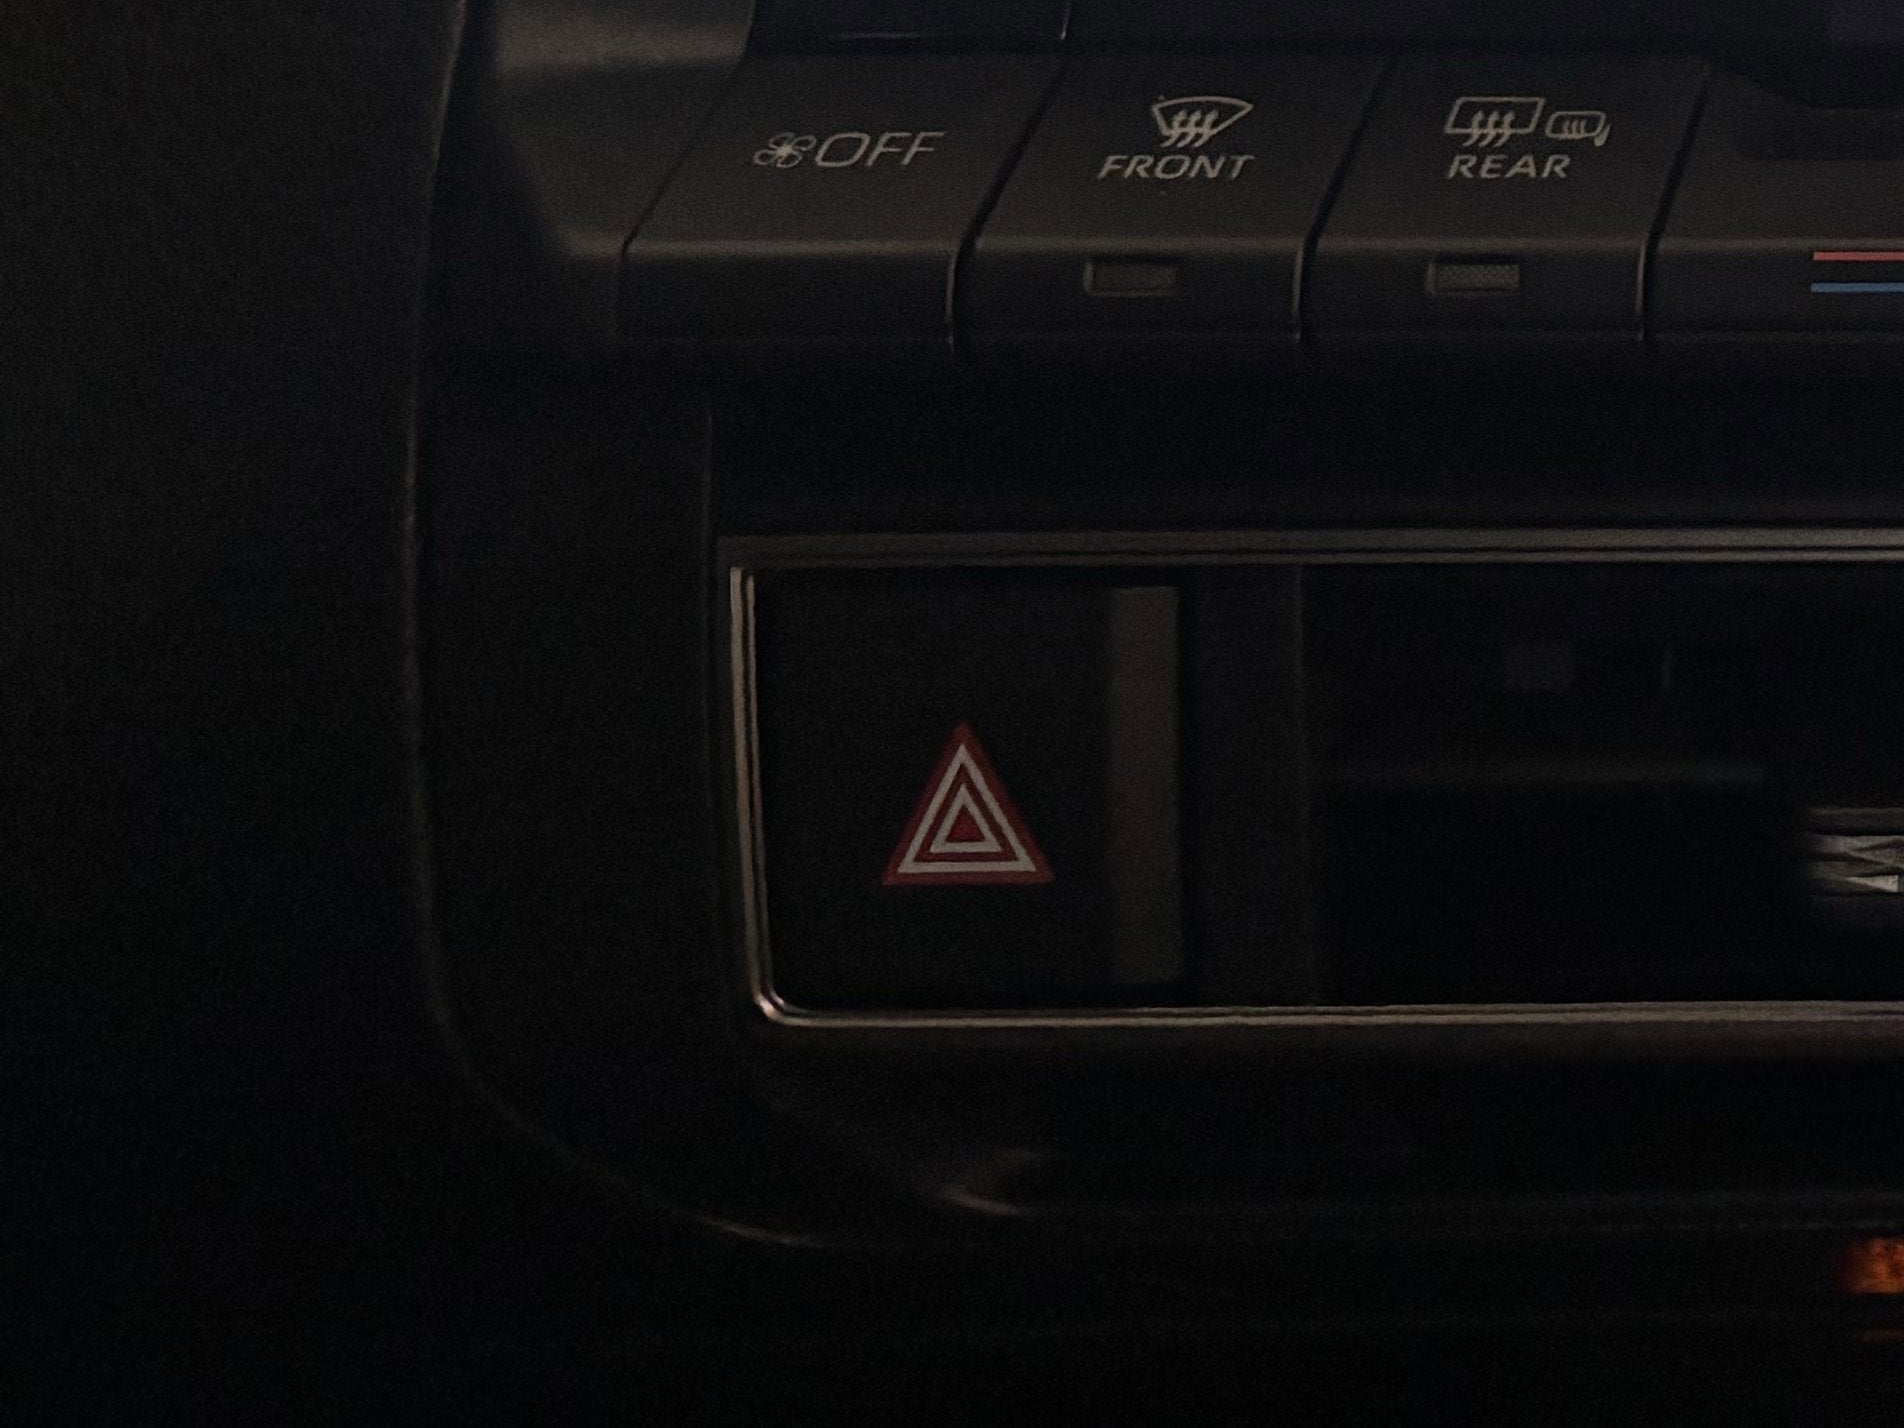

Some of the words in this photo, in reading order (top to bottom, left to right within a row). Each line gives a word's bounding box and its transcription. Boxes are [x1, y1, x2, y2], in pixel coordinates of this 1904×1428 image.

[814, 130, 946, 170] OFF
[1097, 152, 1256, 181] FRONT
[1447, 152, 1571, 180] REAR
